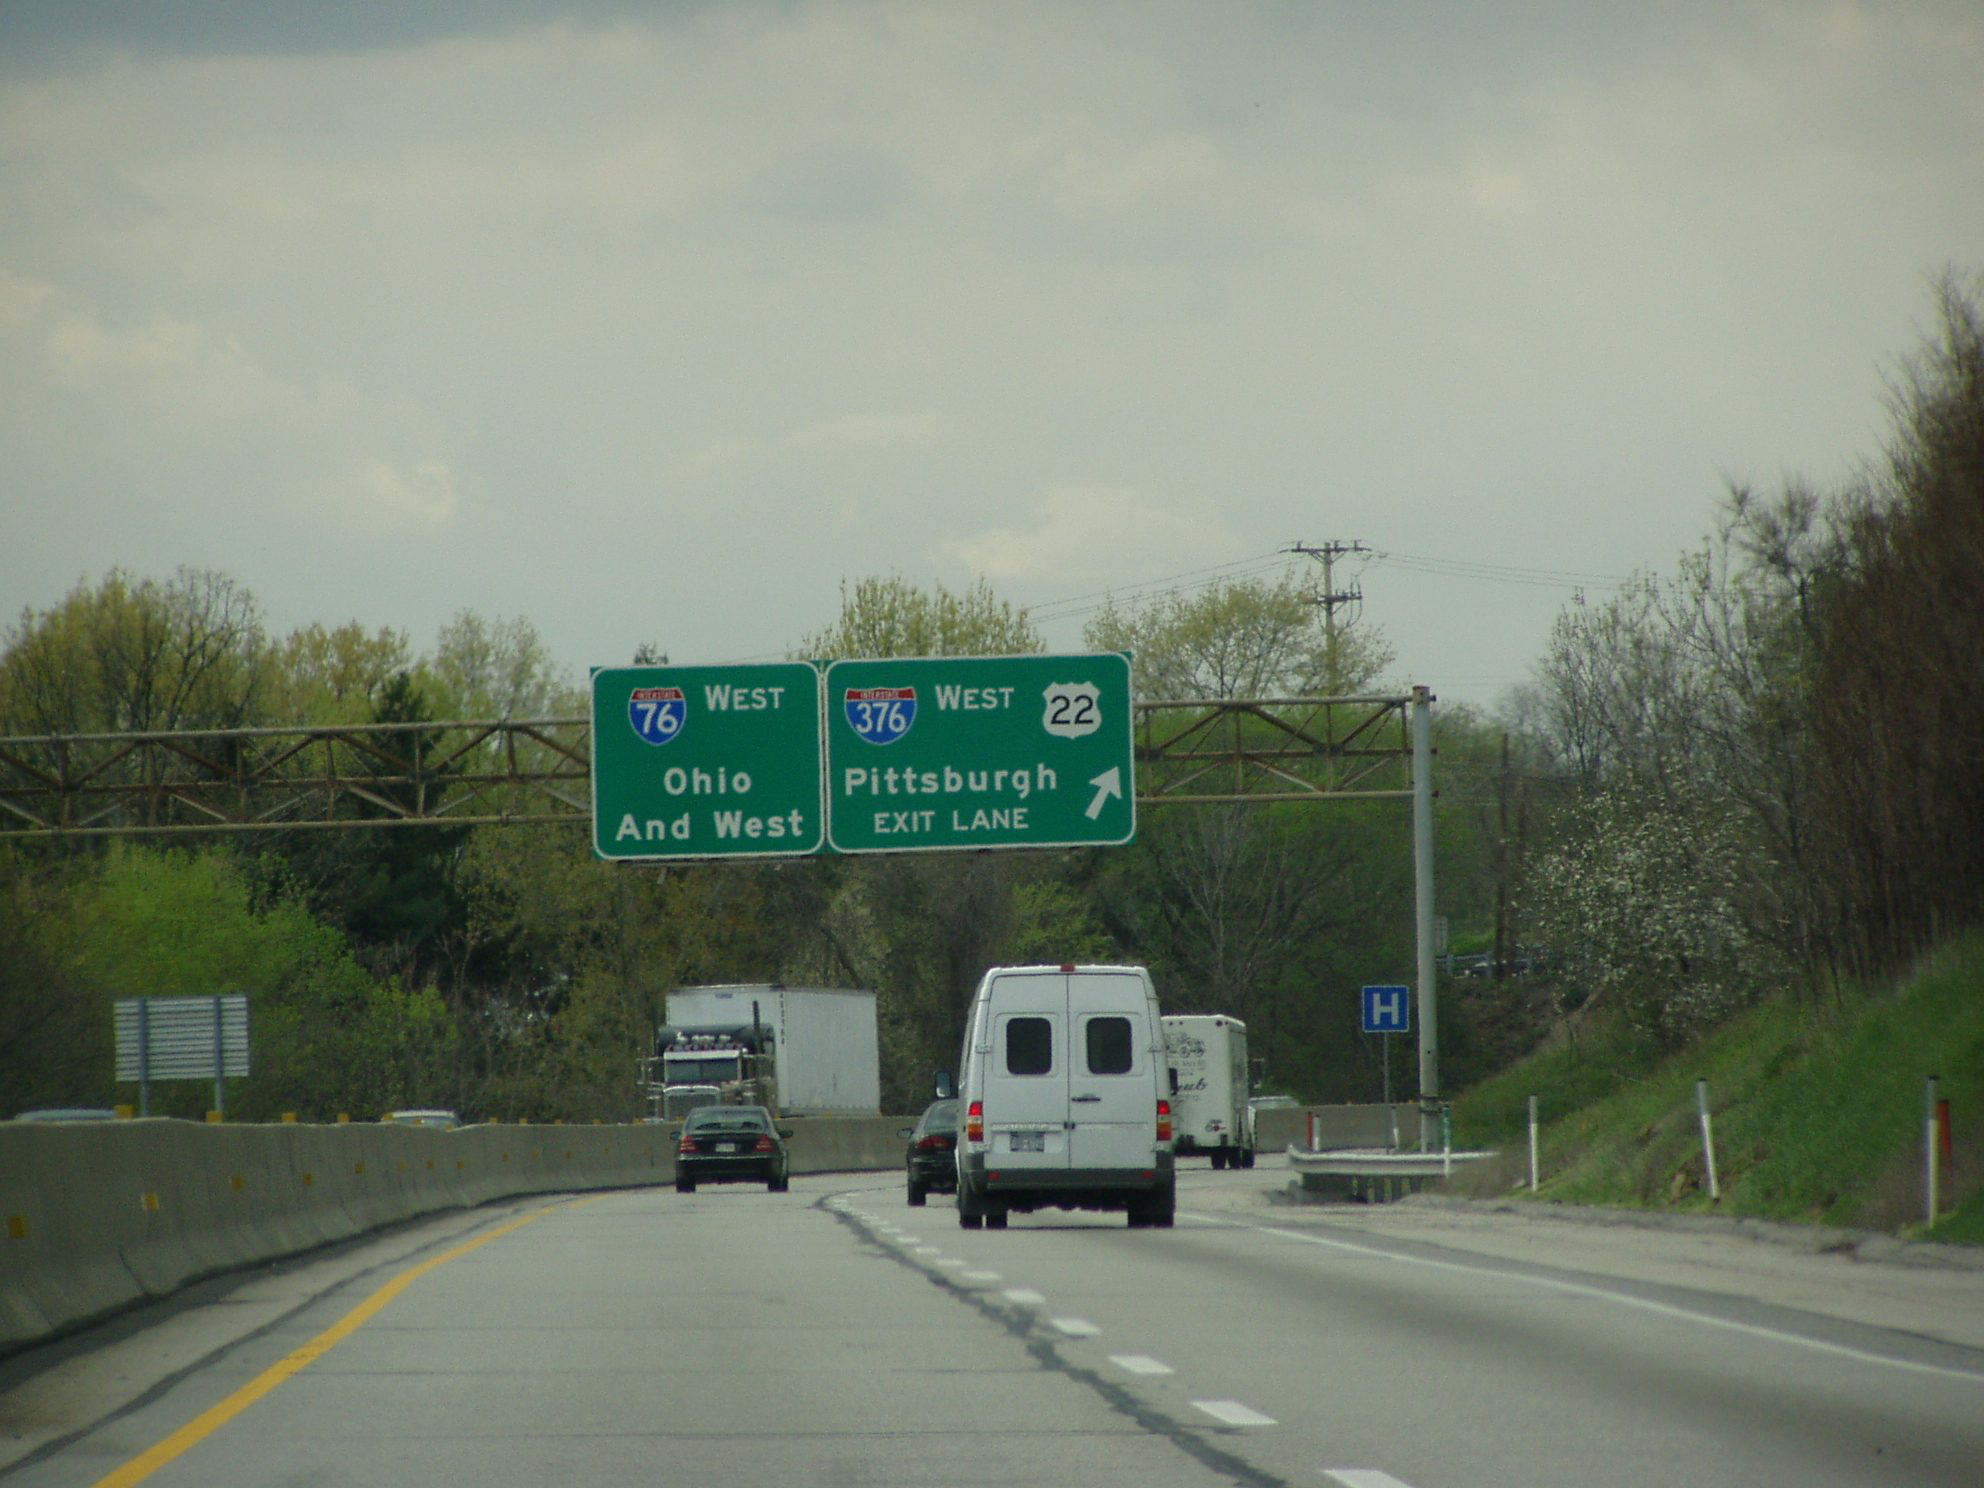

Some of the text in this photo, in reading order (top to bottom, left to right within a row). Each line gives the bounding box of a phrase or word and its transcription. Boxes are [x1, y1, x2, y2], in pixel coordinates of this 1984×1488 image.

[704, 684, 785, 711] WEST
[935, 684, 1014, 710] WEST
[1050, 694, 1094, 725] 22
[636, 702, 678, 734] 76
[855, 702, 906, 733] 376
[663, 767, 752, 795] Ohio
[845, 762, 1057, 798] Pittsburgh
[615, 809, 804, 841] And West
[874, 808, 1029, 833] EXIT LANE
[1372, 993, 1399, 1025] H
